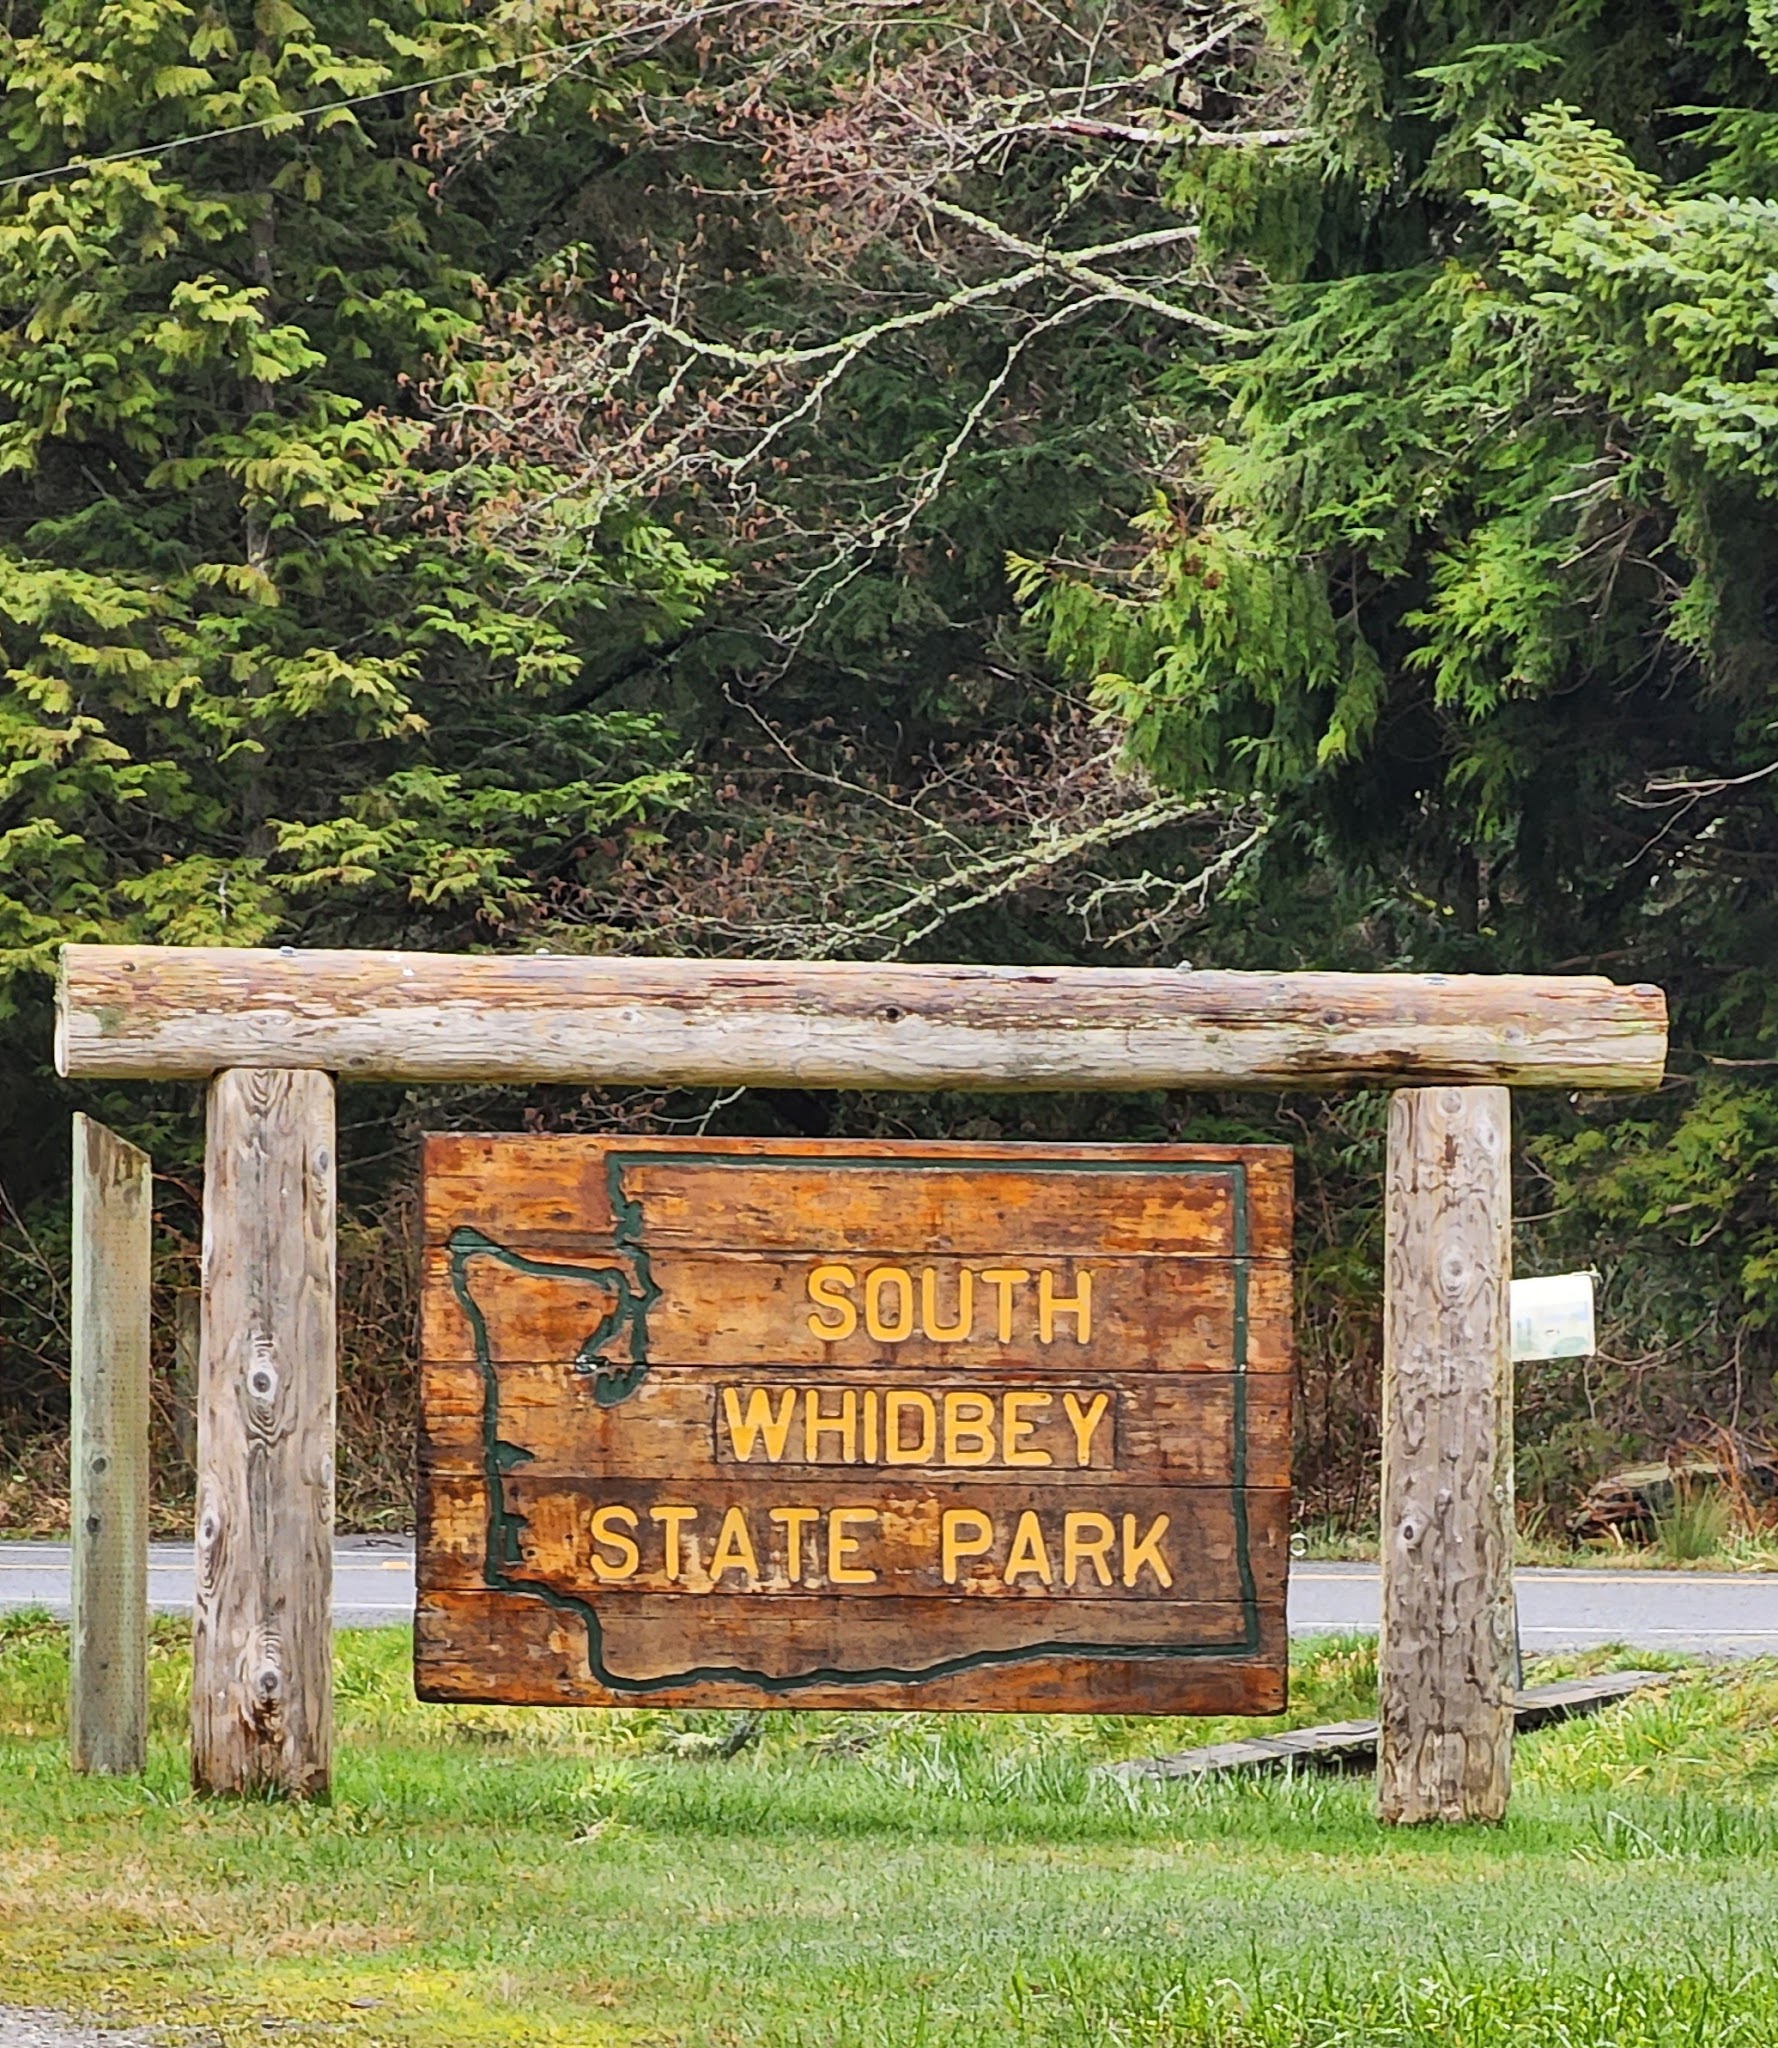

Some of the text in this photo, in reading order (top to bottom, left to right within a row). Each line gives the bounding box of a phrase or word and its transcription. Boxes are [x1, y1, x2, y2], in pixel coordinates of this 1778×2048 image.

[807, 1265, 1093, 1345] SOUTH
[722, 1386, 1110, 1468] WHIDBEY
[590, 1505, 1174, 1589] STATE PARK
